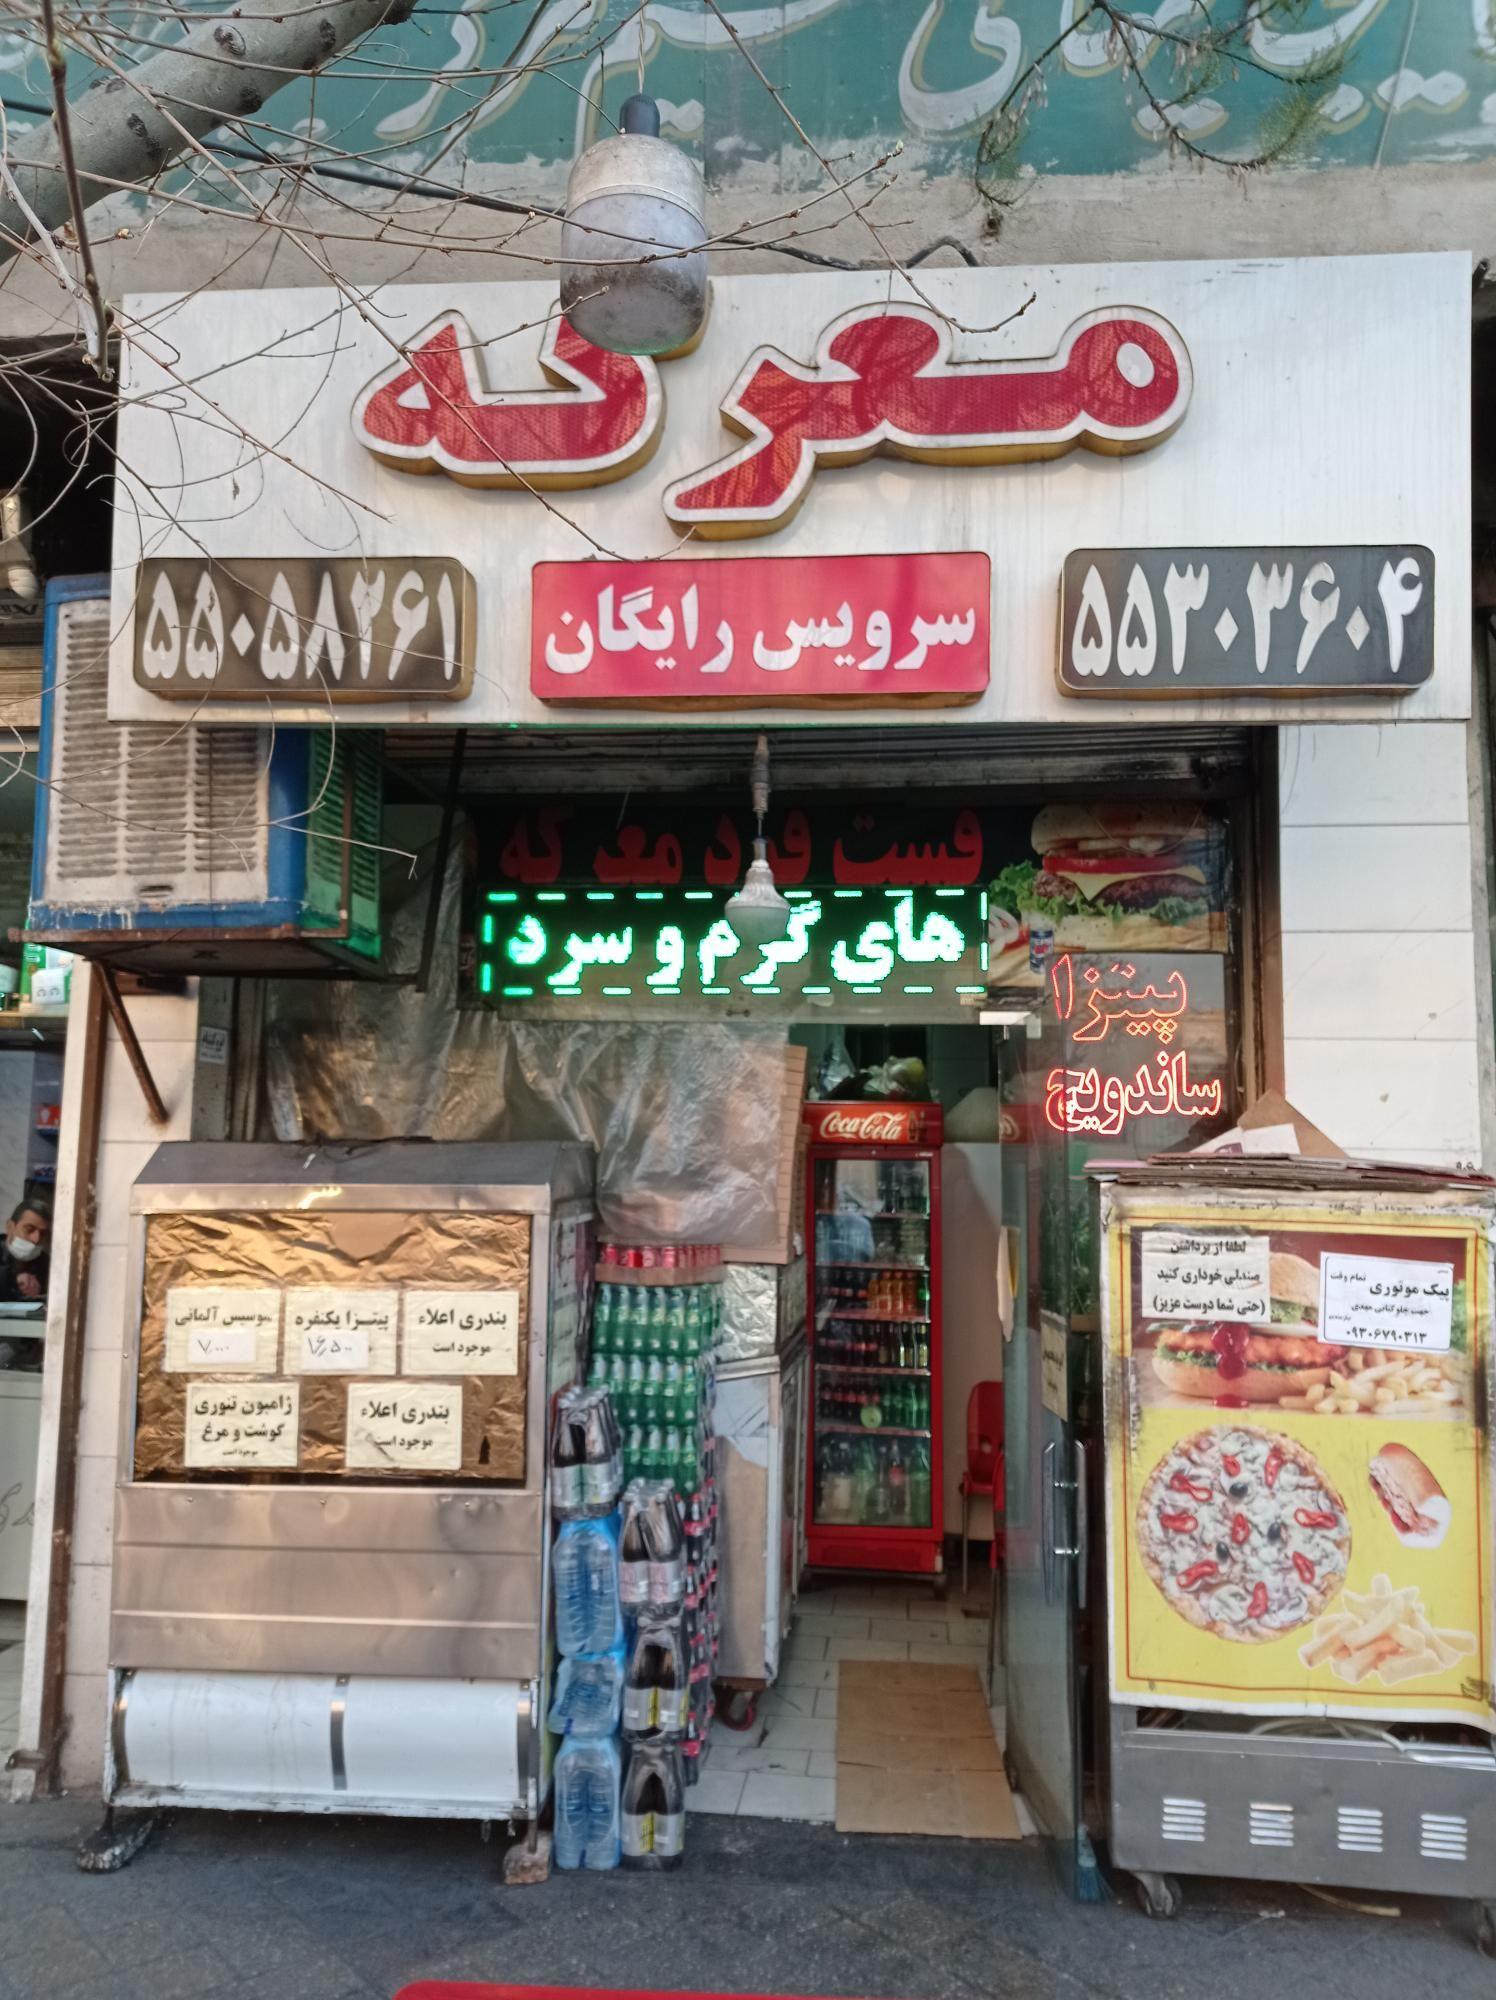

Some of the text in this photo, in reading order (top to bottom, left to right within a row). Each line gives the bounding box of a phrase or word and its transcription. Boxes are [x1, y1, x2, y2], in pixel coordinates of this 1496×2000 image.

[142, 570, 459, 682] ۵۵۰۵۸۲۶۱
[1071, 556, 1424, 678] ۵۵۳۰۳۶۰۴
[544, 583, 976, 674] سرویس رایگان
[832, 808, 984, 885] فست
[507, 895, 966, 986] های گرم و سرد
[1050, 951, 1188, 1044] پیتزا
[1045, 1050, 1222, 1135] ساندویچ
[820, 1111, 908, 1141] Coca-Cola
[1213, 1240, 1223, 1256] از
[1225, 1239, 1247, 1253] لطفا
[1157, 1267, 1180, 1283] کنید
[1224, 1268, 1260, 1286] صندلی
[1369, 1280, 1450, 1302] پیک موتوری
[1182, 1299, 1215, 1315] دوست
[1216, 1297, 1235, 1311] شما
[175, 1305, 272, 1327] سوسیس آلمانی
[295, 1309, 389, 1332] پیتزا یکنفره
[418, 1308, 507, 1331] بندری اعلاء
[432, 1341, 492, 1357] موجود است
[194, 1394, 292, 1416] ژامبون تنوری
[360, 1400, 450, 1425] بندری اعلاء
[200, 1421, 230, 1443] مرغ
[232, 1427, 241, 1443] و
[373, 1434, 434, 1451] موجود است
